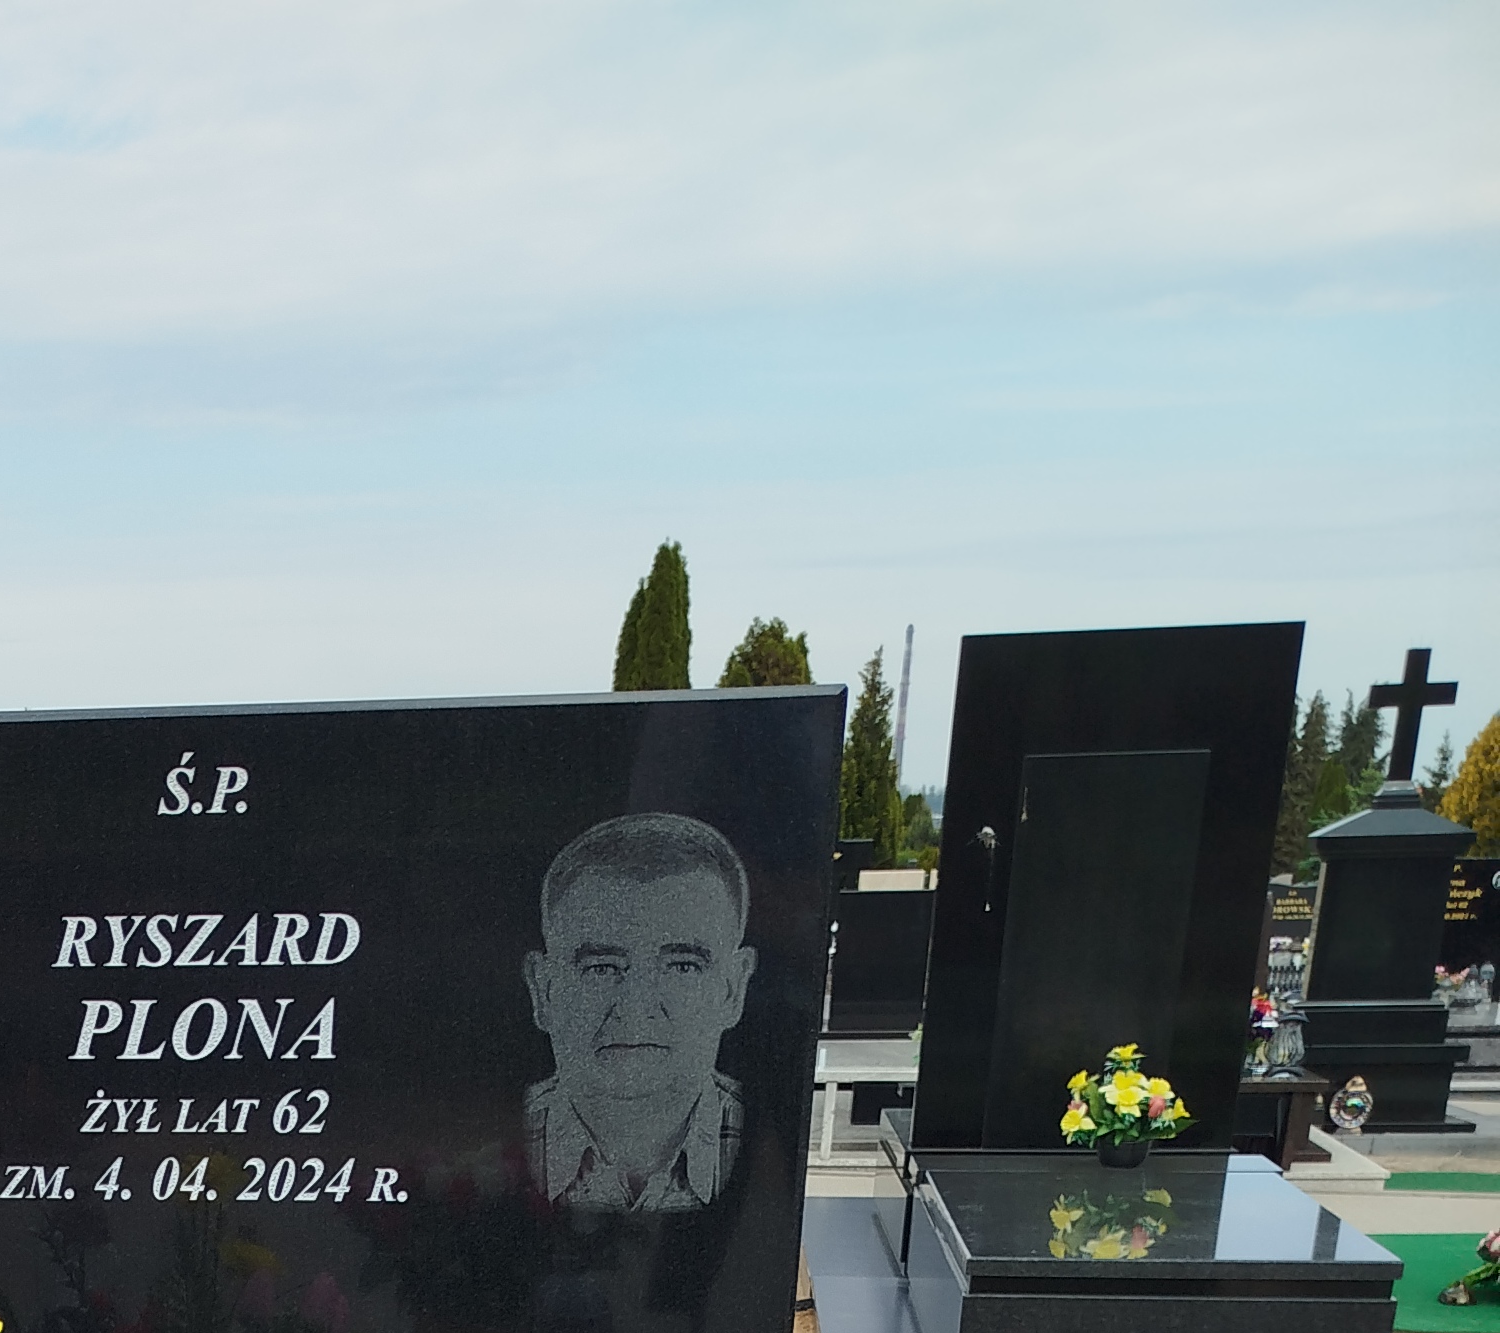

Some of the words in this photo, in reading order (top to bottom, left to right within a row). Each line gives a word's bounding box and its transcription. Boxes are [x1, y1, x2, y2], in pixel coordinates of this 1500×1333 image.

[51, 913, 361, 968] RYSZARD
[68, 997, 337, 1060] PLONA
[80, 1089, 162, 1133] ŻYŁ
[172, 1098, 260, 1133] LAT
[273, 1088, 330, 1134] 62
[0, 1165, 75, 1200] ZM.
[94, 1156, 132, 1201] 4.
[153, 1156, 218, 1201] 04.
[236, 1157, 356, 1203] 2024
[366, 1167, 408, 1203] R.
